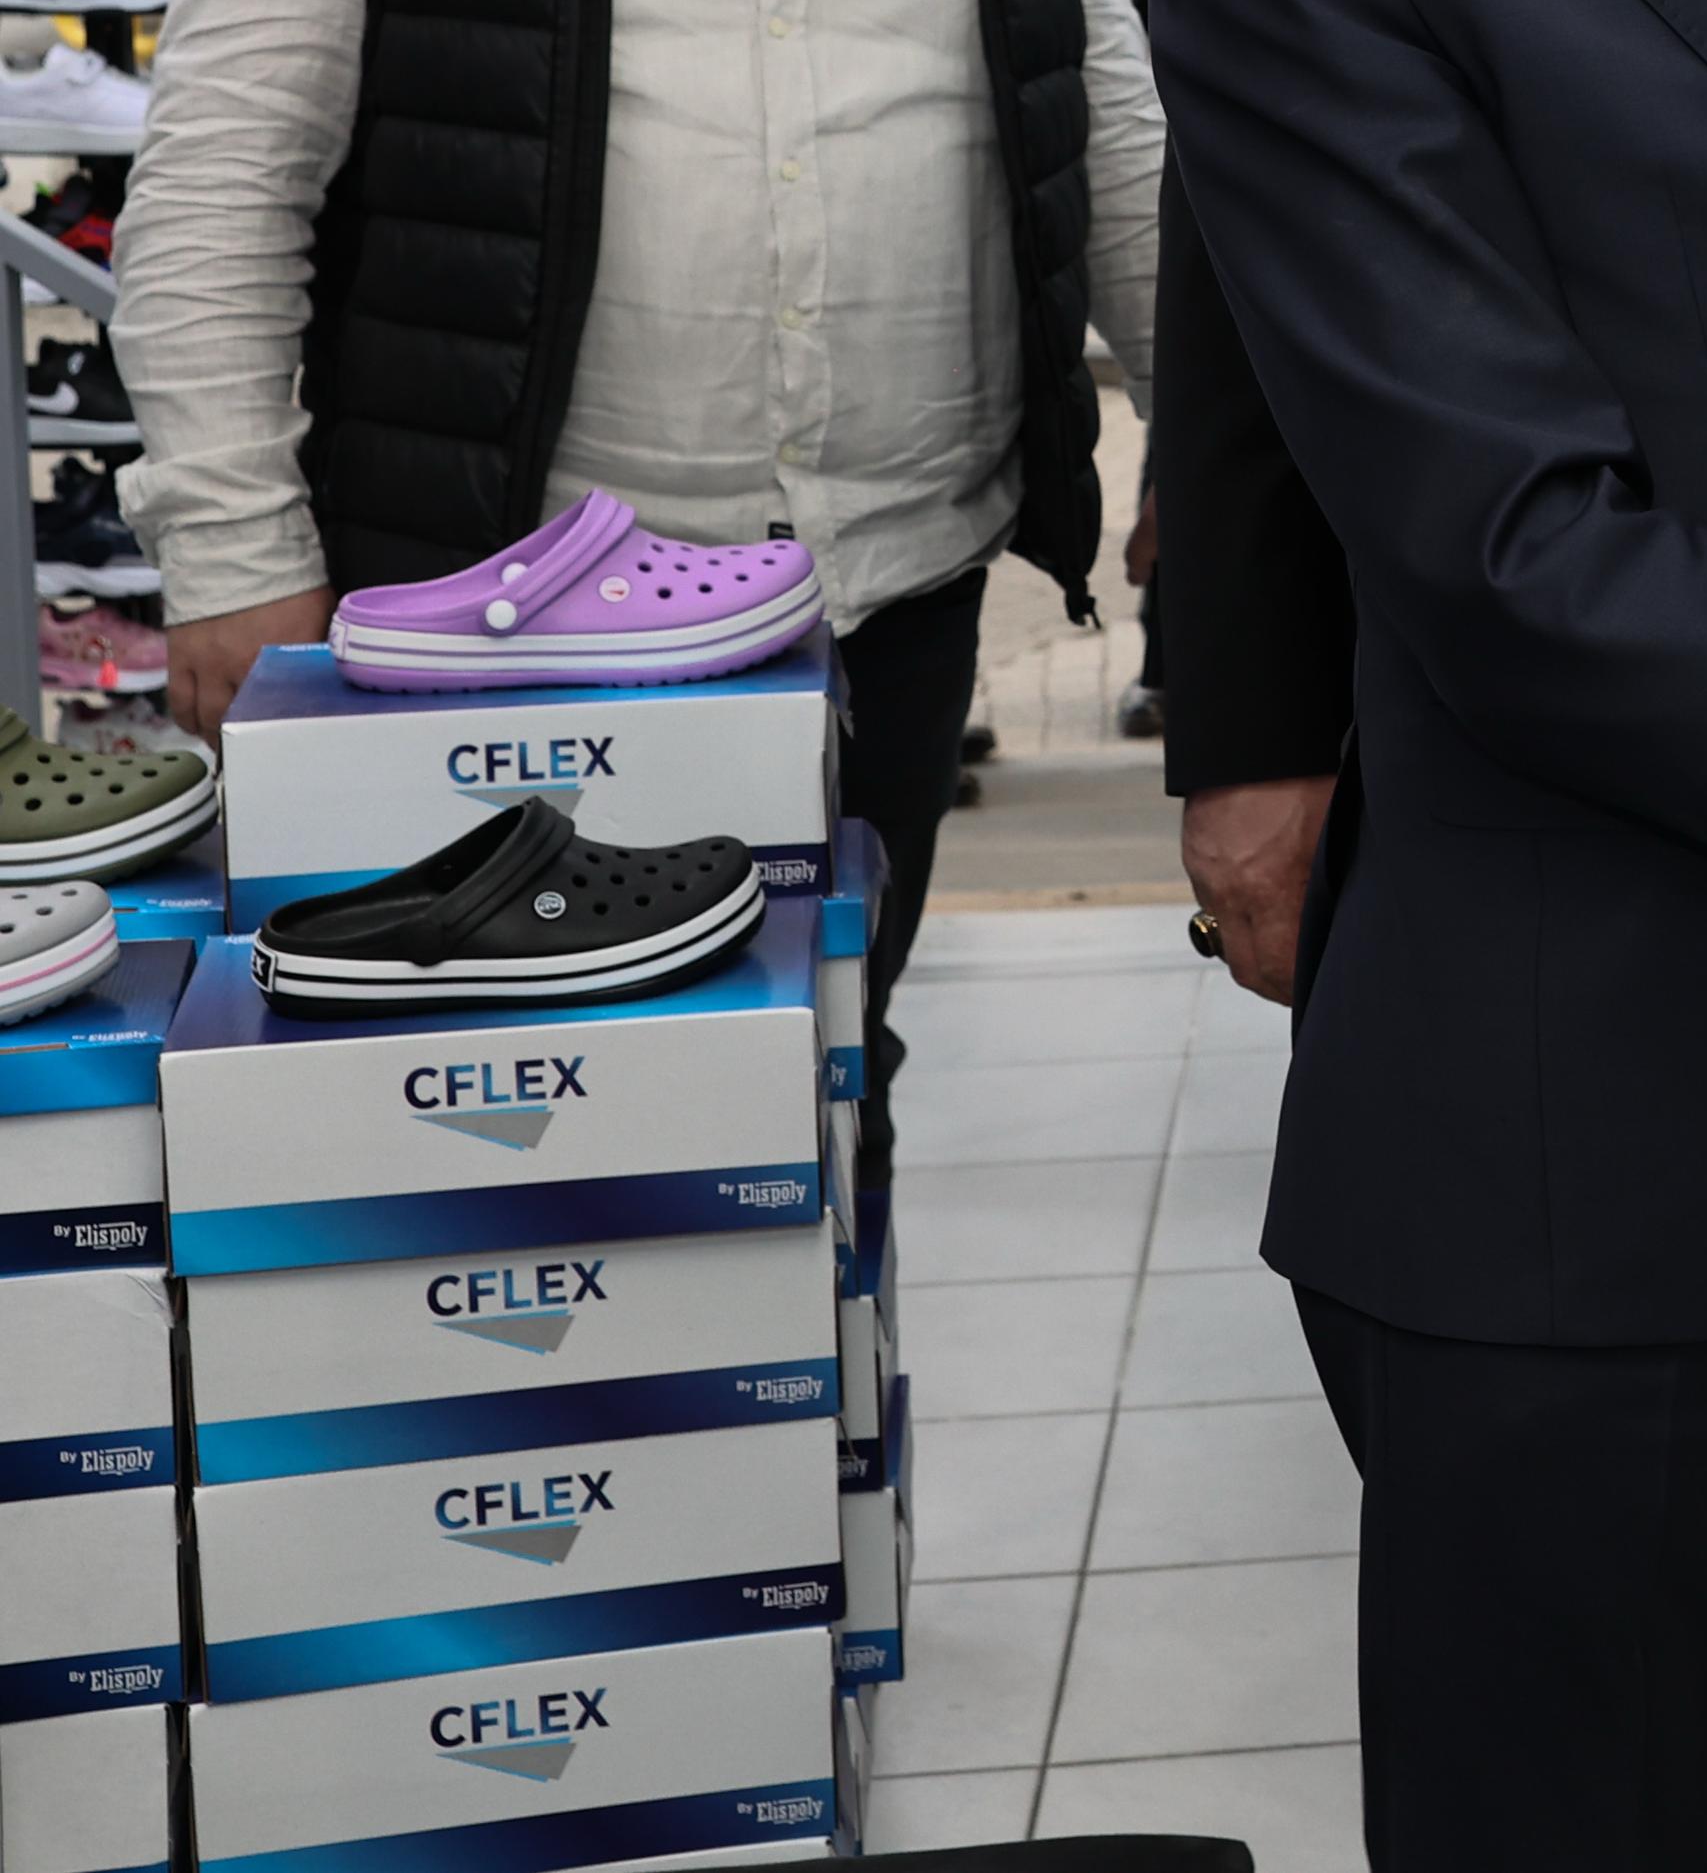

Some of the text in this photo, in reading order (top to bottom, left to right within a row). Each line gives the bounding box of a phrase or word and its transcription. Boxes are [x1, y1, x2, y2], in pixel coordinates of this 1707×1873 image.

[446, 736, 617, 786] CFLEX
[402, 1055, 589, 1110] CFLEX
[718, 1181, 806, 1208] By Elispoly
[53, 1221, 148, 1250] By Elispoly
[426, 1260, 608, 1317] CFLEX
[755, 1376, 823, 1403] Elispoly
[60, 1446, 154, 1475] By Elispoly
[434, 1470, 615, 1529] CFLEX
[762, 1581, 829, 1609] Elispoly
[69, 1664, 163, 1694] By Elispoly
[428, 1688, 610, 1748] CFLEX
[756, 1796, 825, 1825] Elispoly
